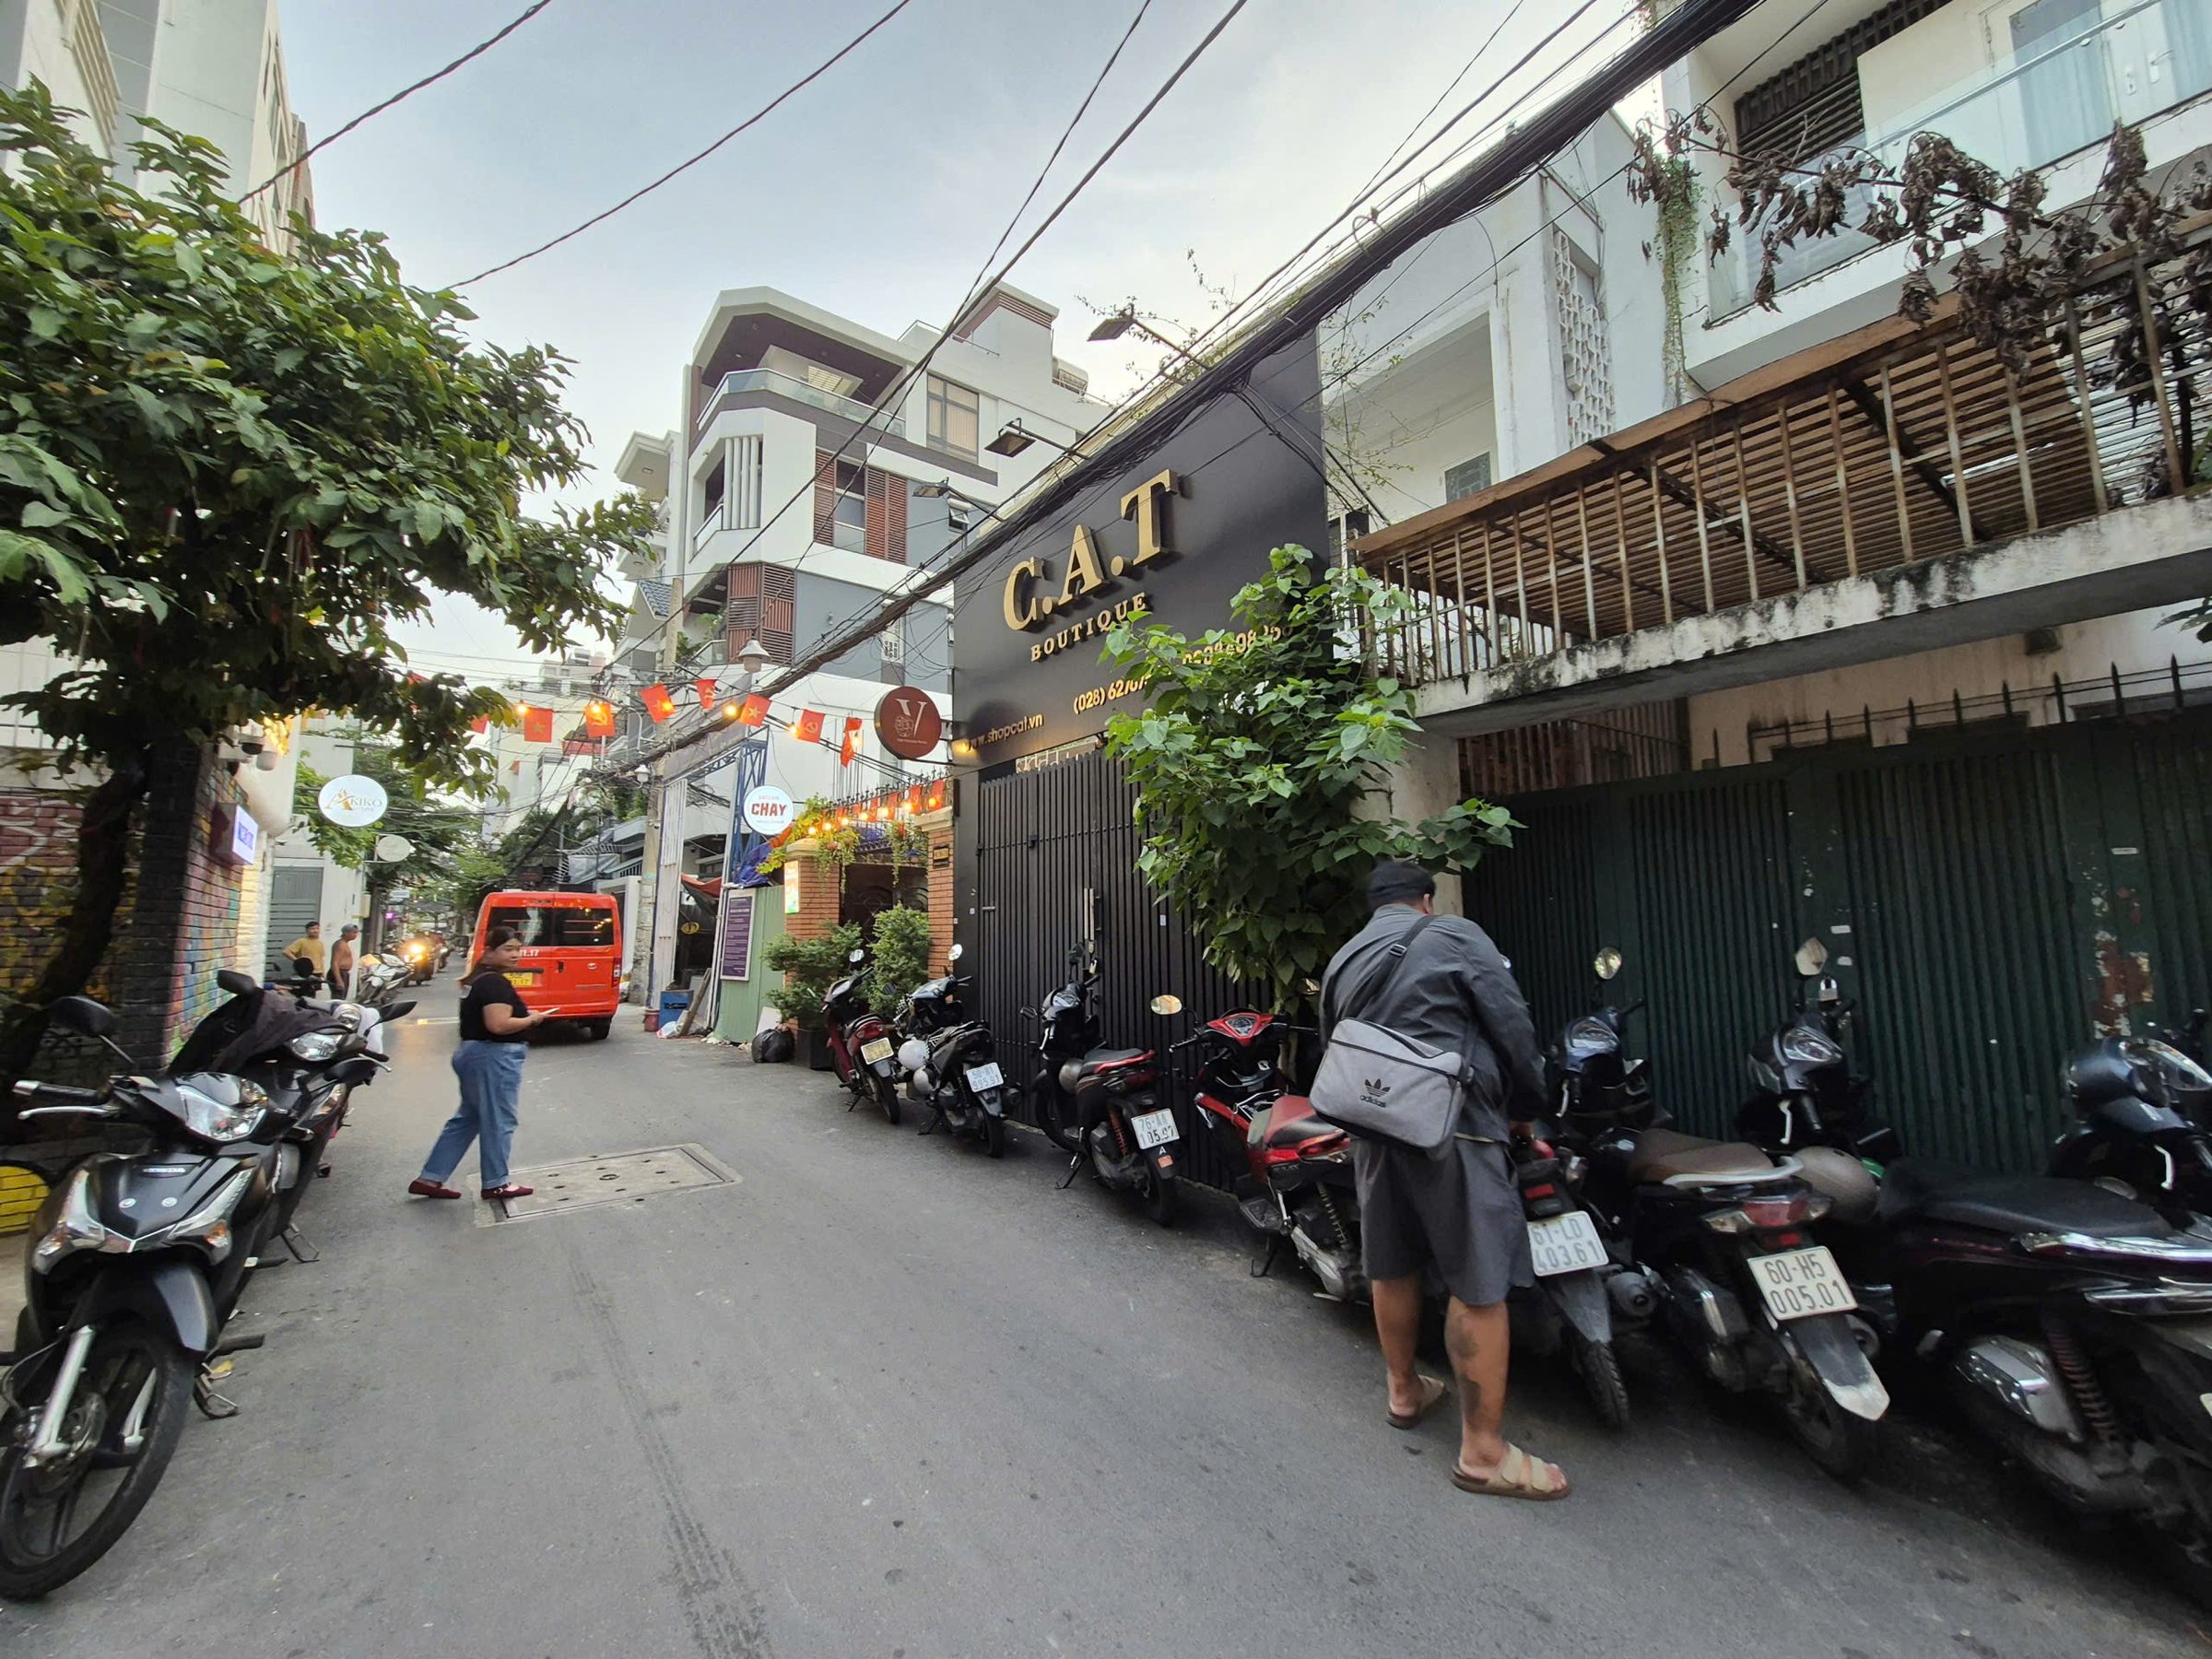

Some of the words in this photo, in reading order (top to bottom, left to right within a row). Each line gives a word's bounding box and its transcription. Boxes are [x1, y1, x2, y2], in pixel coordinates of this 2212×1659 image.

[1004, 468, 1177, 631] C.A.T
[1030, 591, 1148, 663] BOUTIQUE
[1073, 686, 1106, 715] (028)
[965, 713, 1043, 750] ww.shopcat.vn
[751, 802, 787, 817] CHAY
[1359, 1095, 1387, 1108] adidas
[1764, 1253, 1826, 1285] 60-H5
[1770, 1279, 1849, 1314] 005.01
